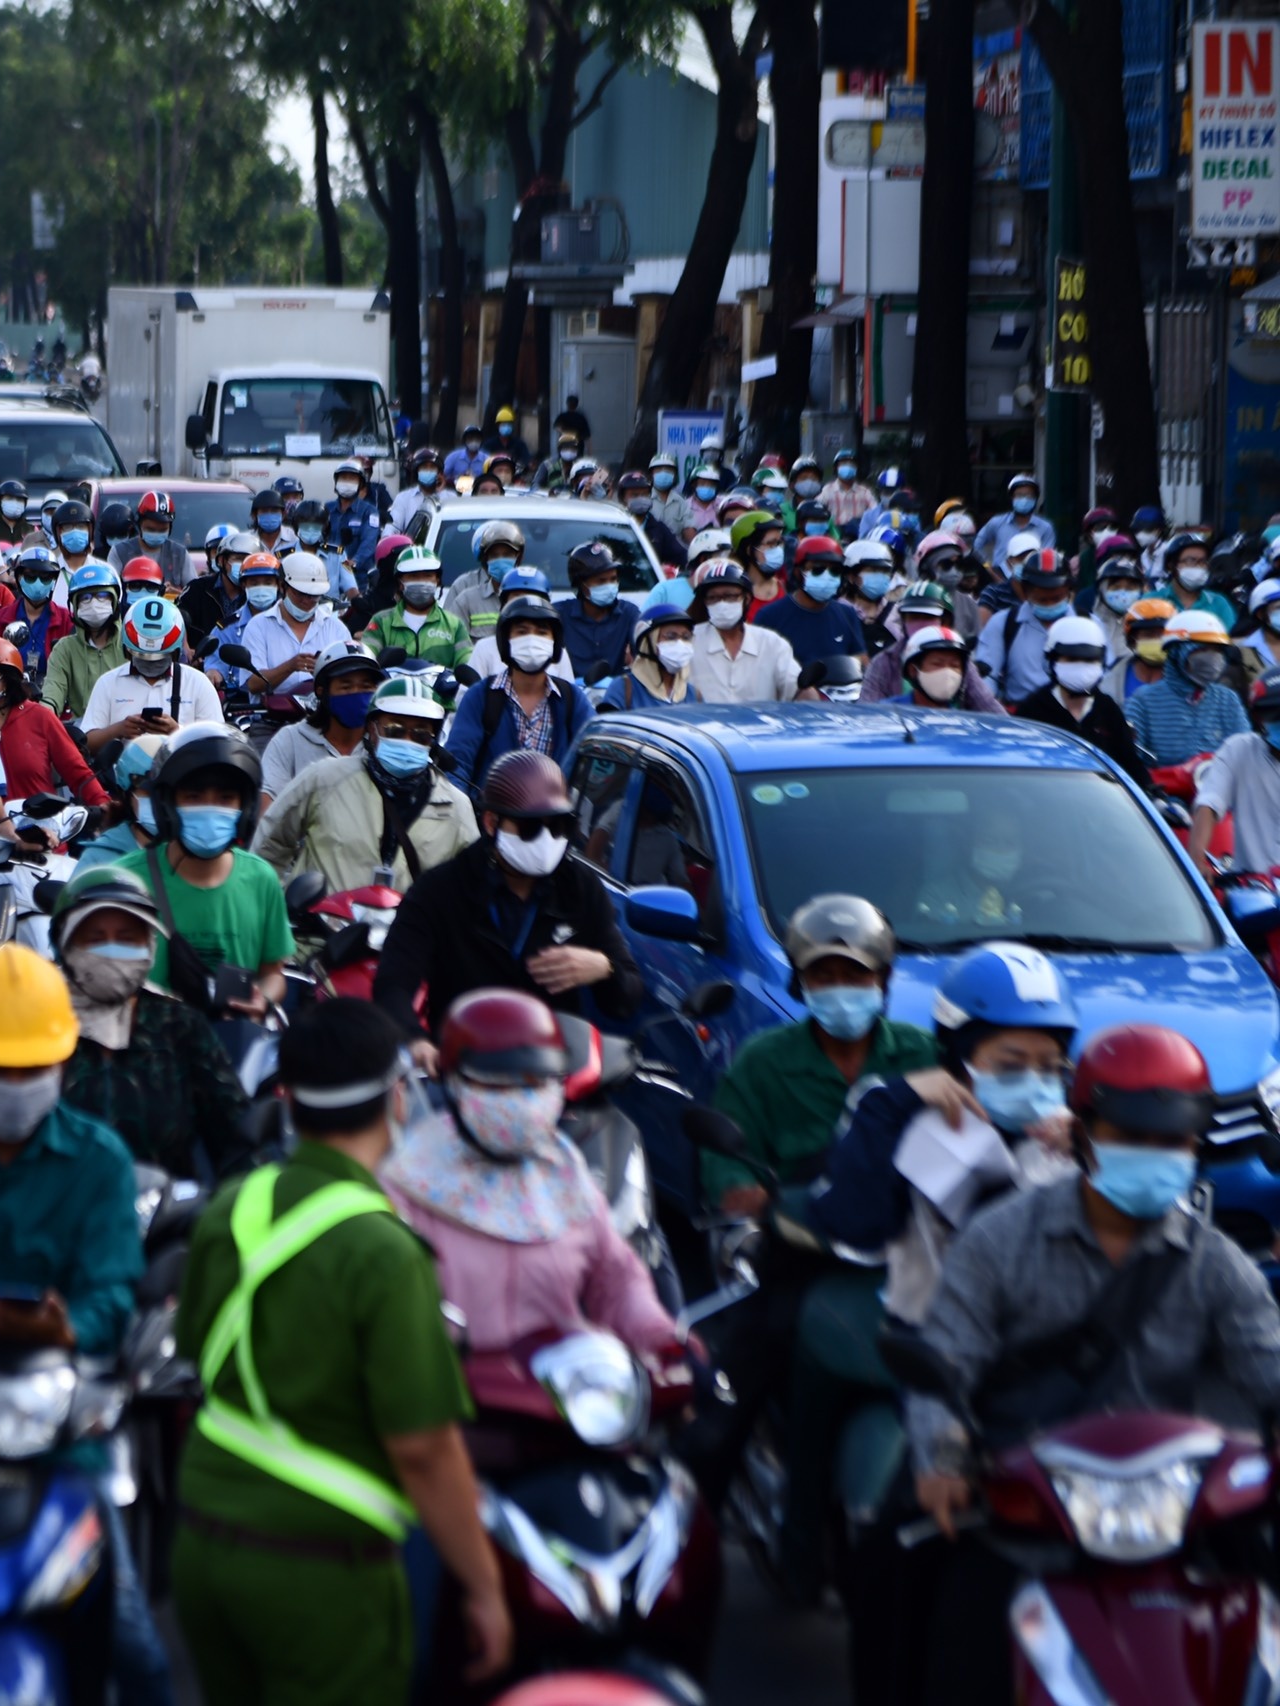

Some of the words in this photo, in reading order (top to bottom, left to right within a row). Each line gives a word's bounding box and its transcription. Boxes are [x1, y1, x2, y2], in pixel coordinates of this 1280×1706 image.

[1204, 30, 1273, 98] IN
[1200, 127, 1276, 150] HIFLEX
[1202, 159, 1273, 180] DECAL
[1222, 187, 1253, 211] PP
[427, 628, 452, 640] Grab
